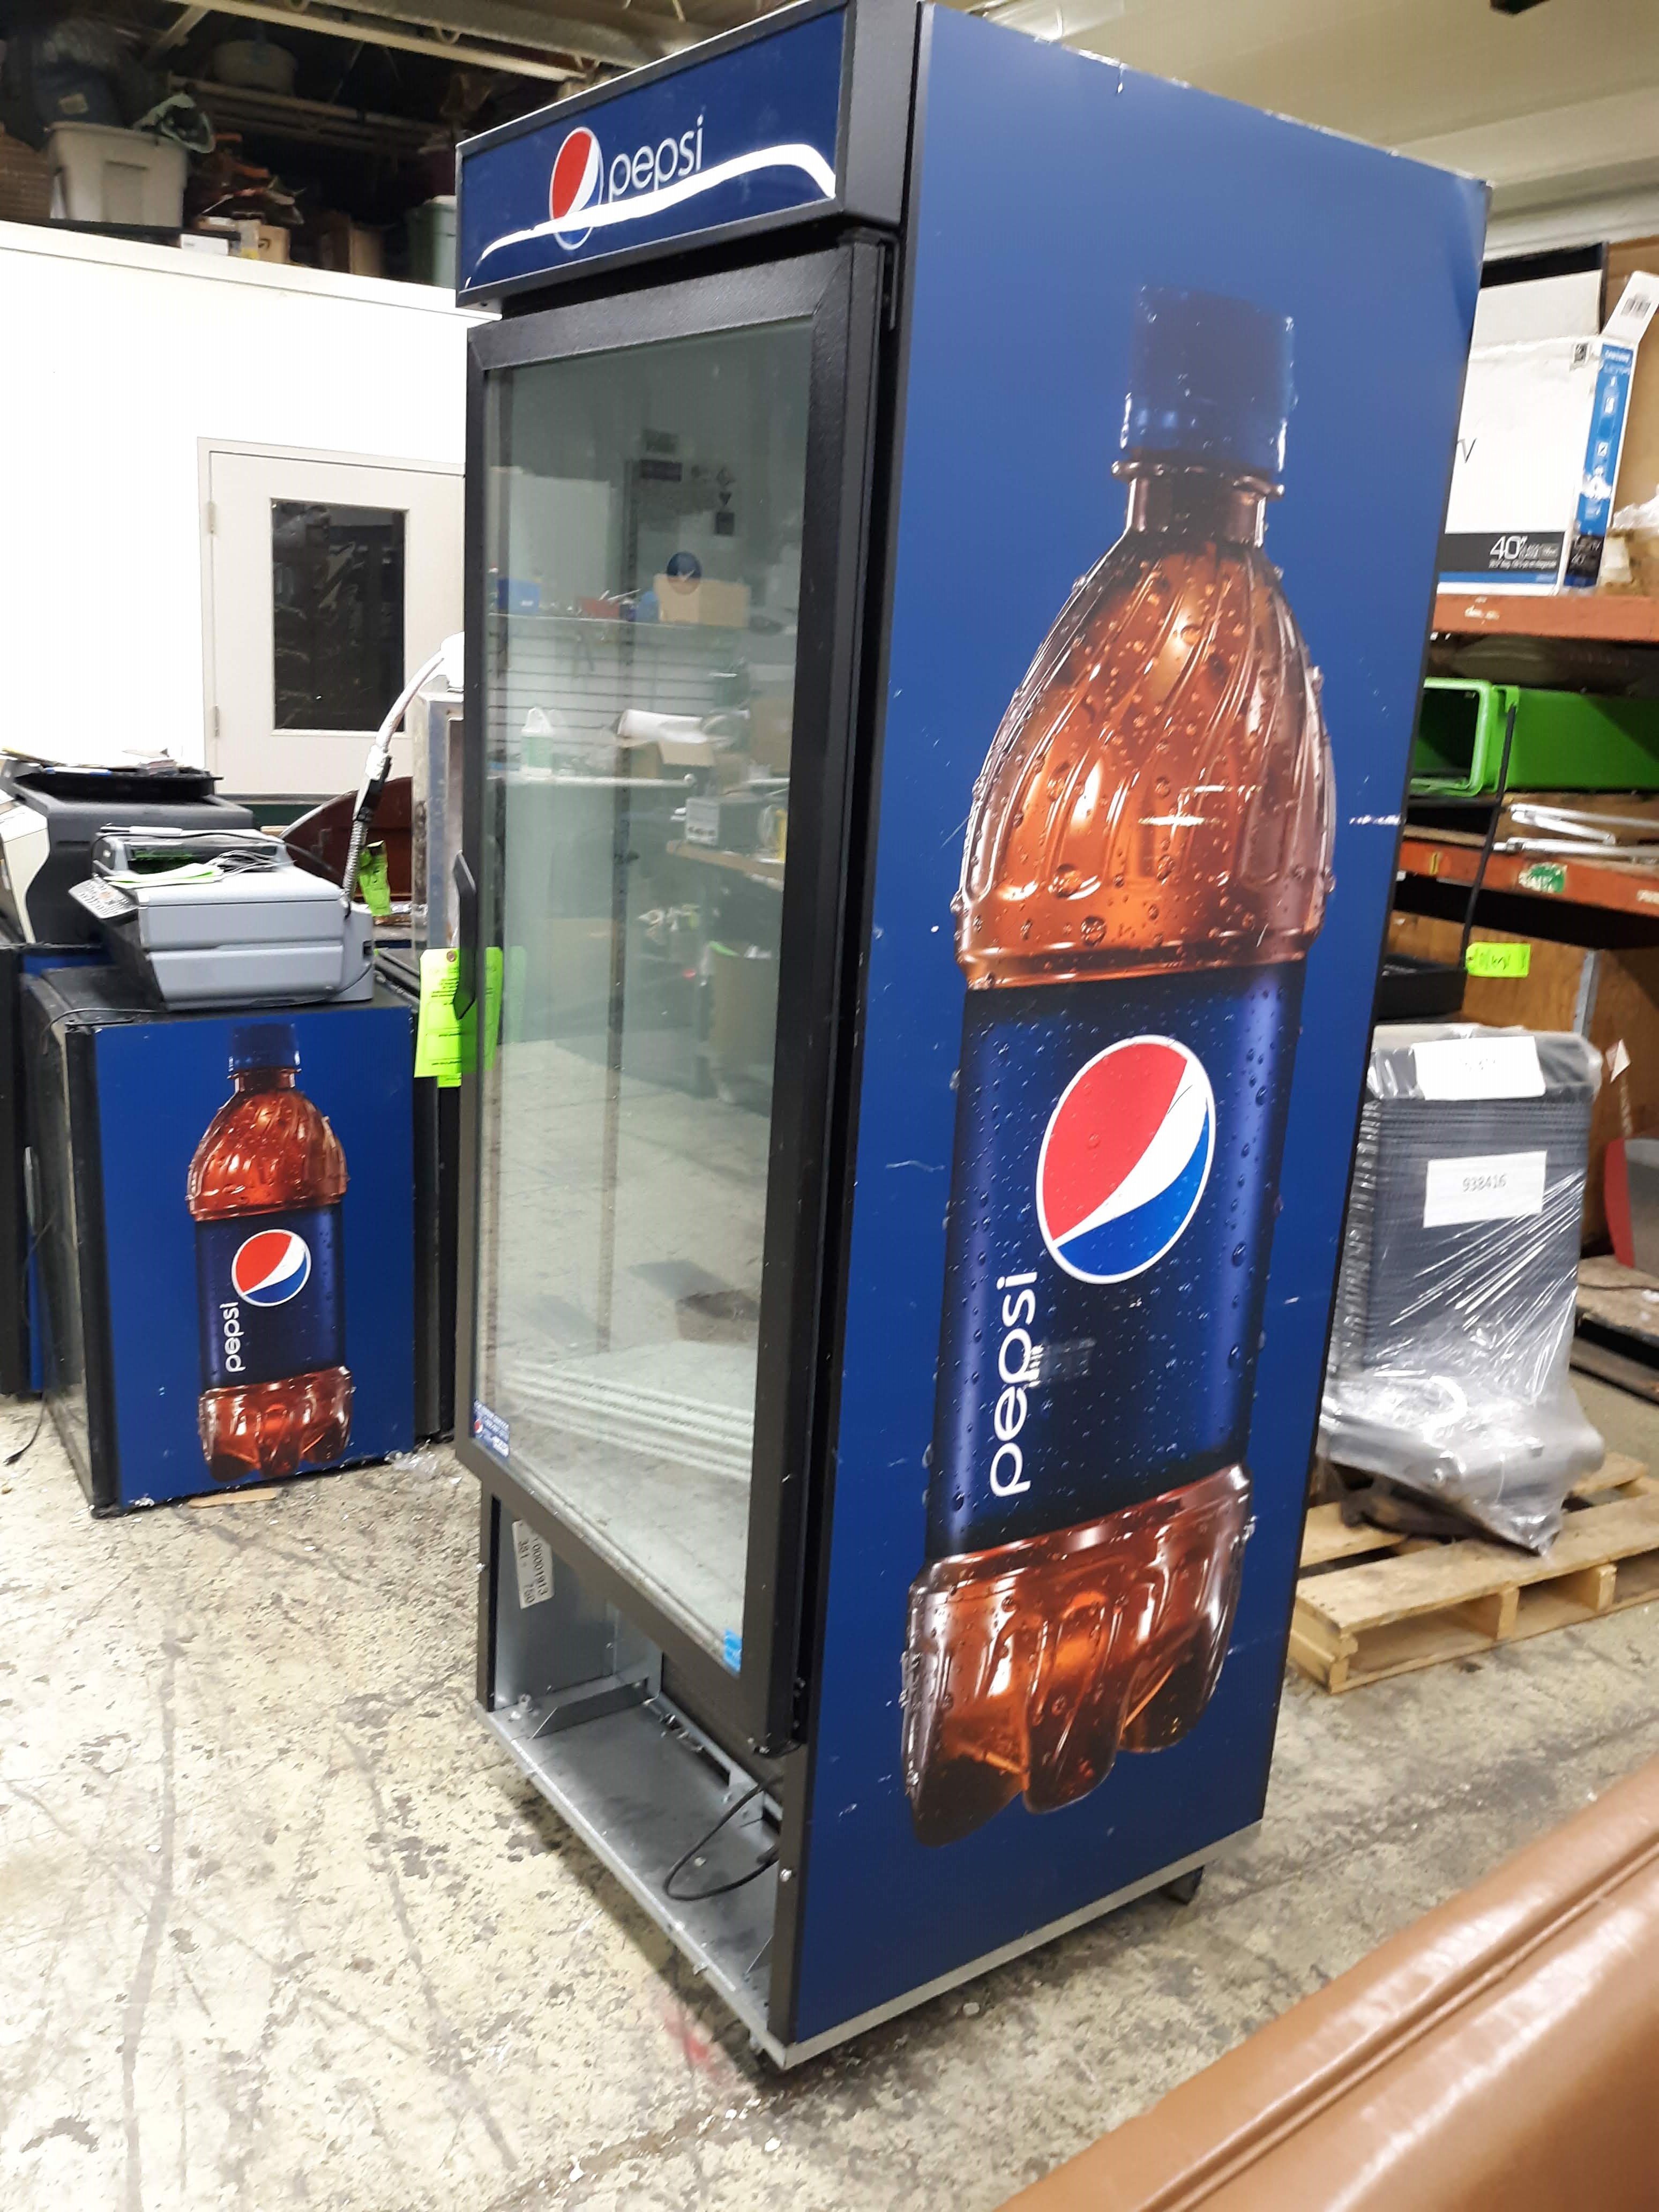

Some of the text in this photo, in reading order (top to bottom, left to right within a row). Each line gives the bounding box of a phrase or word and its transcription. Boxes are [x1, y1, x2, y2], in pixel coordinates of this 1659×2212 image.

[608, 114, 704, 203] pepsi
[219, 1302, 246, 1373] pepsi
[990, 1272, 1045, 1498] pepsi
